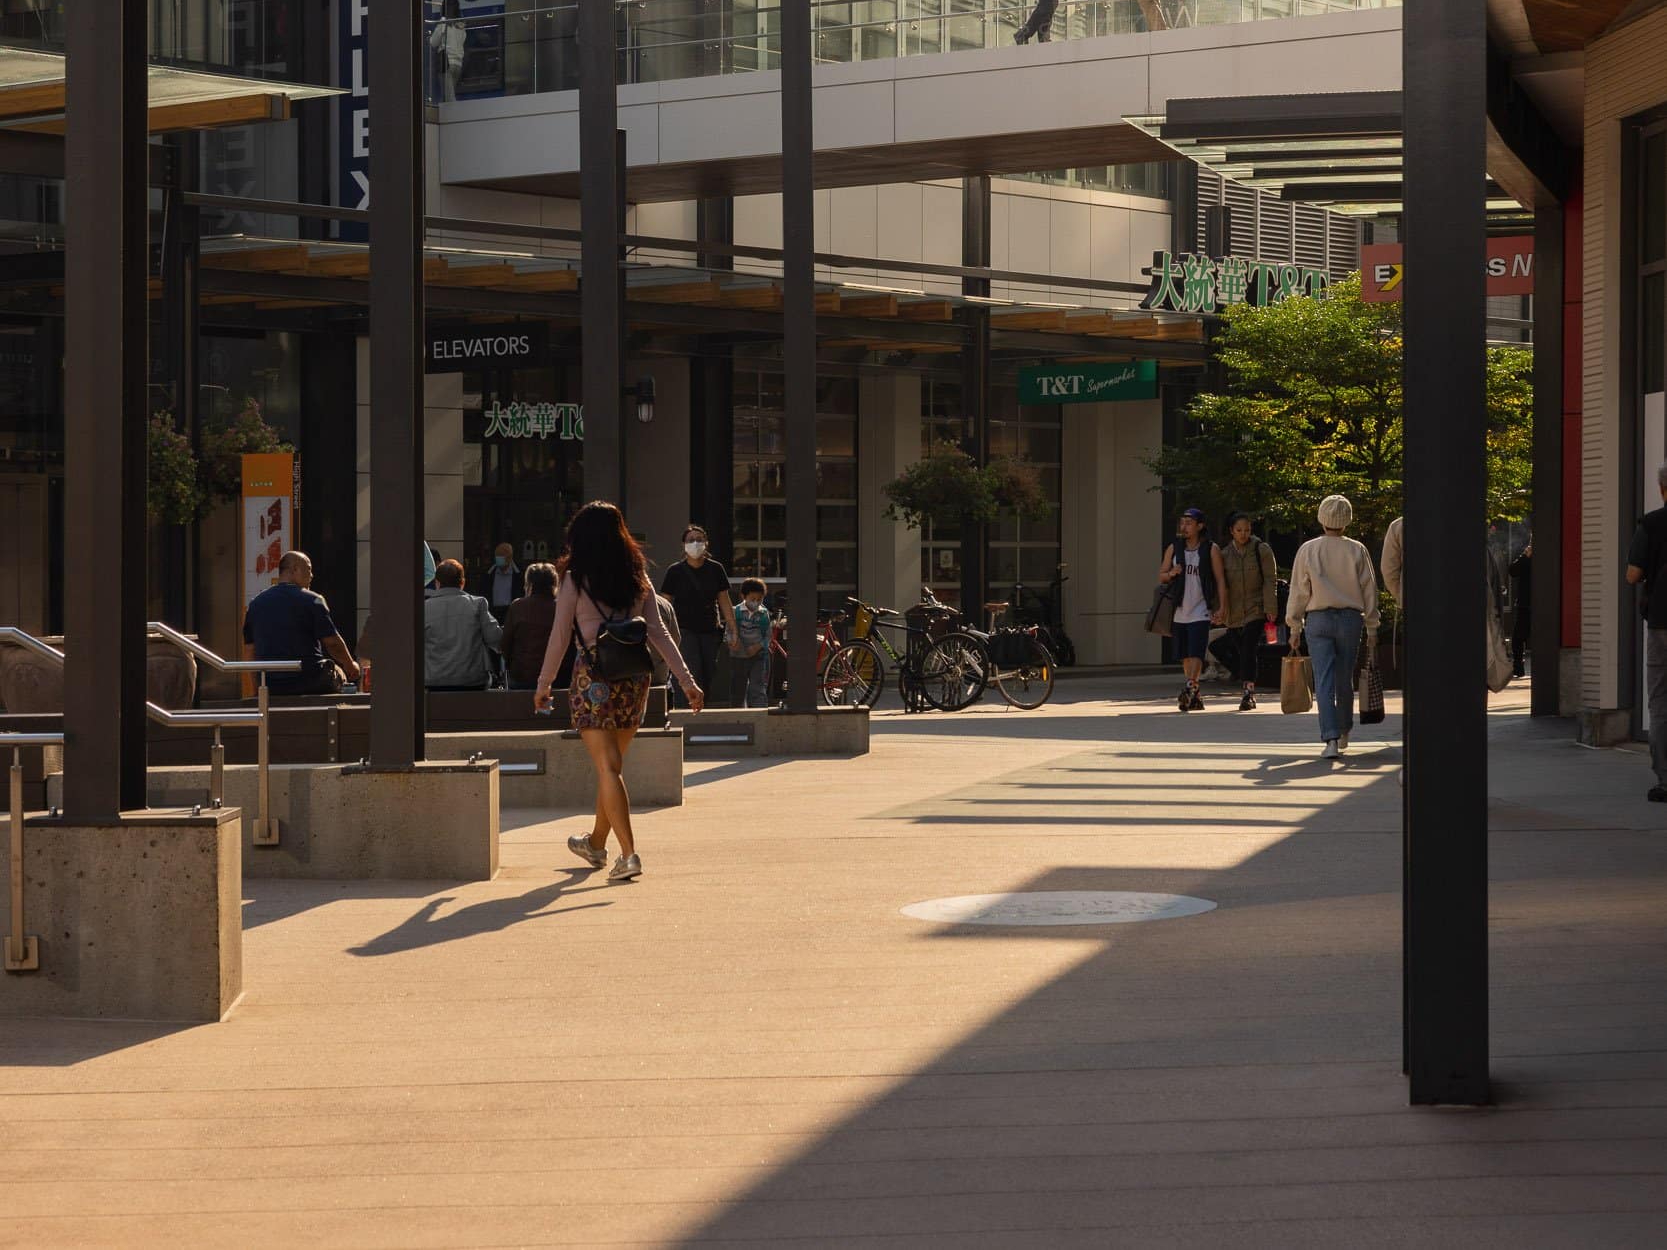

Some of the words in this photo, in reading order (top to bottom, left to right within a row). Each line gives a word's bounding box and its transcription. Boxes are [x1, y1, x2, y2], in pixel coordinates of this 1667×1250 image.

[1149, 250, 1248, 313] 大統華
[1248, 260, 1330, 309] T&T
[433, 335, 530, 360] ELEVATORS
[1036, 374, 1085, 397] T&T
[1086, 366, 1137, 396] Supermarket
[483, 400, 556, 440] 大統華
